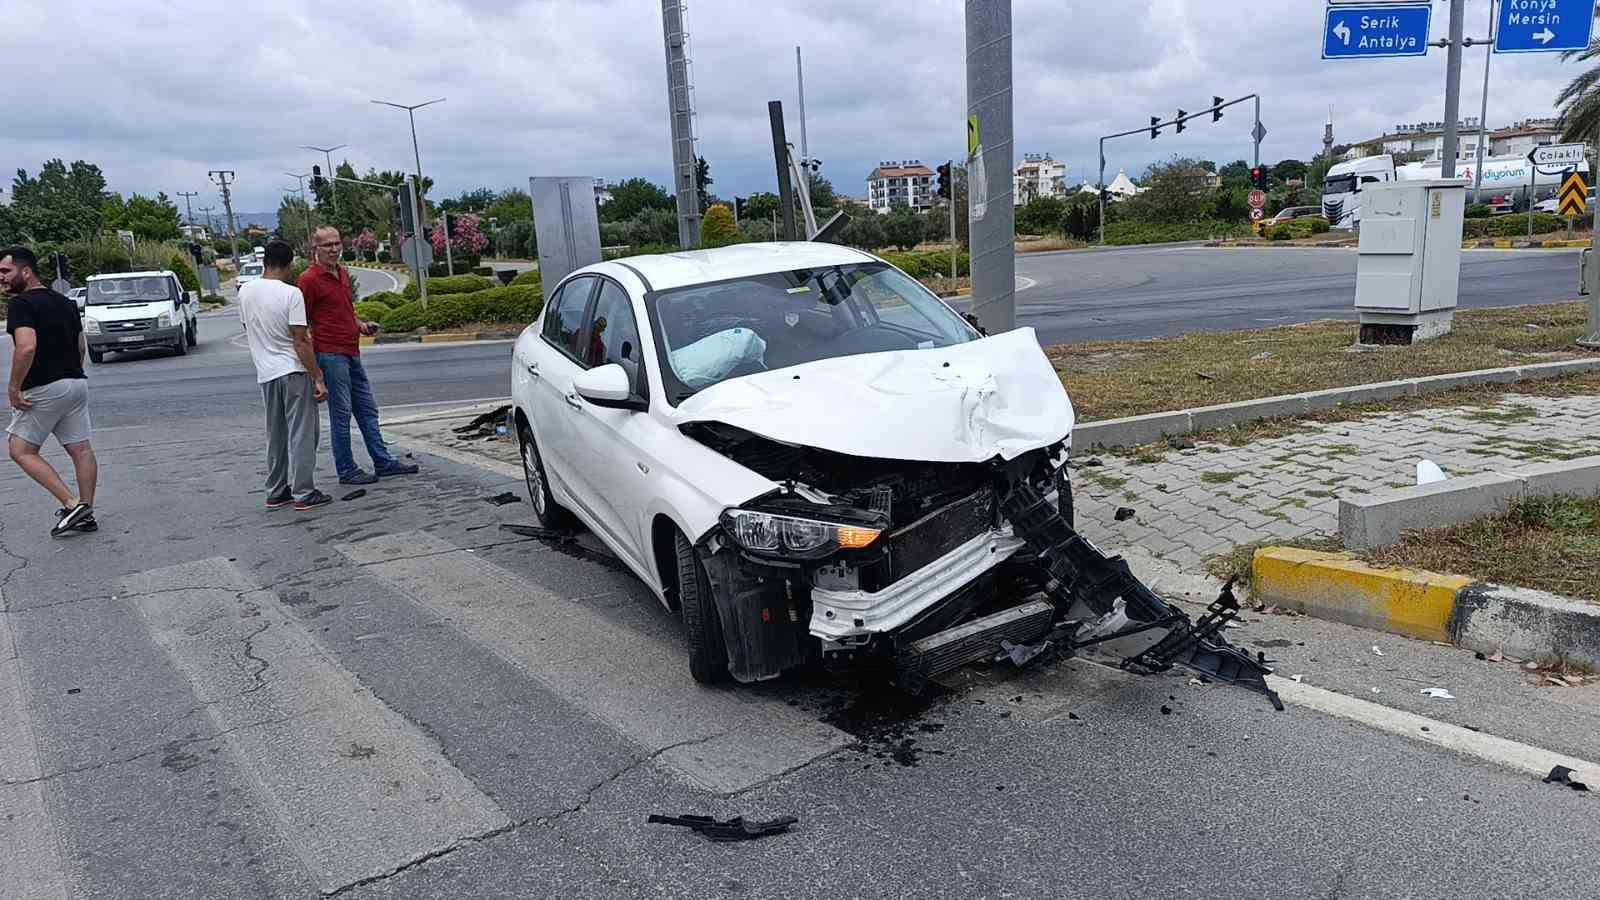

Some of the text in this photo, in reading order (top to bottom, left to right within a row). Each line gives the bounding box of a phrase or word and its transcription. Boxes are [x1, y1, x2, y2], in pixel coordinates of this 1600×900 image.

[1510, 0, 1557, 13] Konya
[1360, 15, 1399, 29] Serik
[1508, 12, 1560, 26] Mersin
[1358, 33, 1416, 50] Antalya
[1539, 149, 1580, 161] Çolaklı
